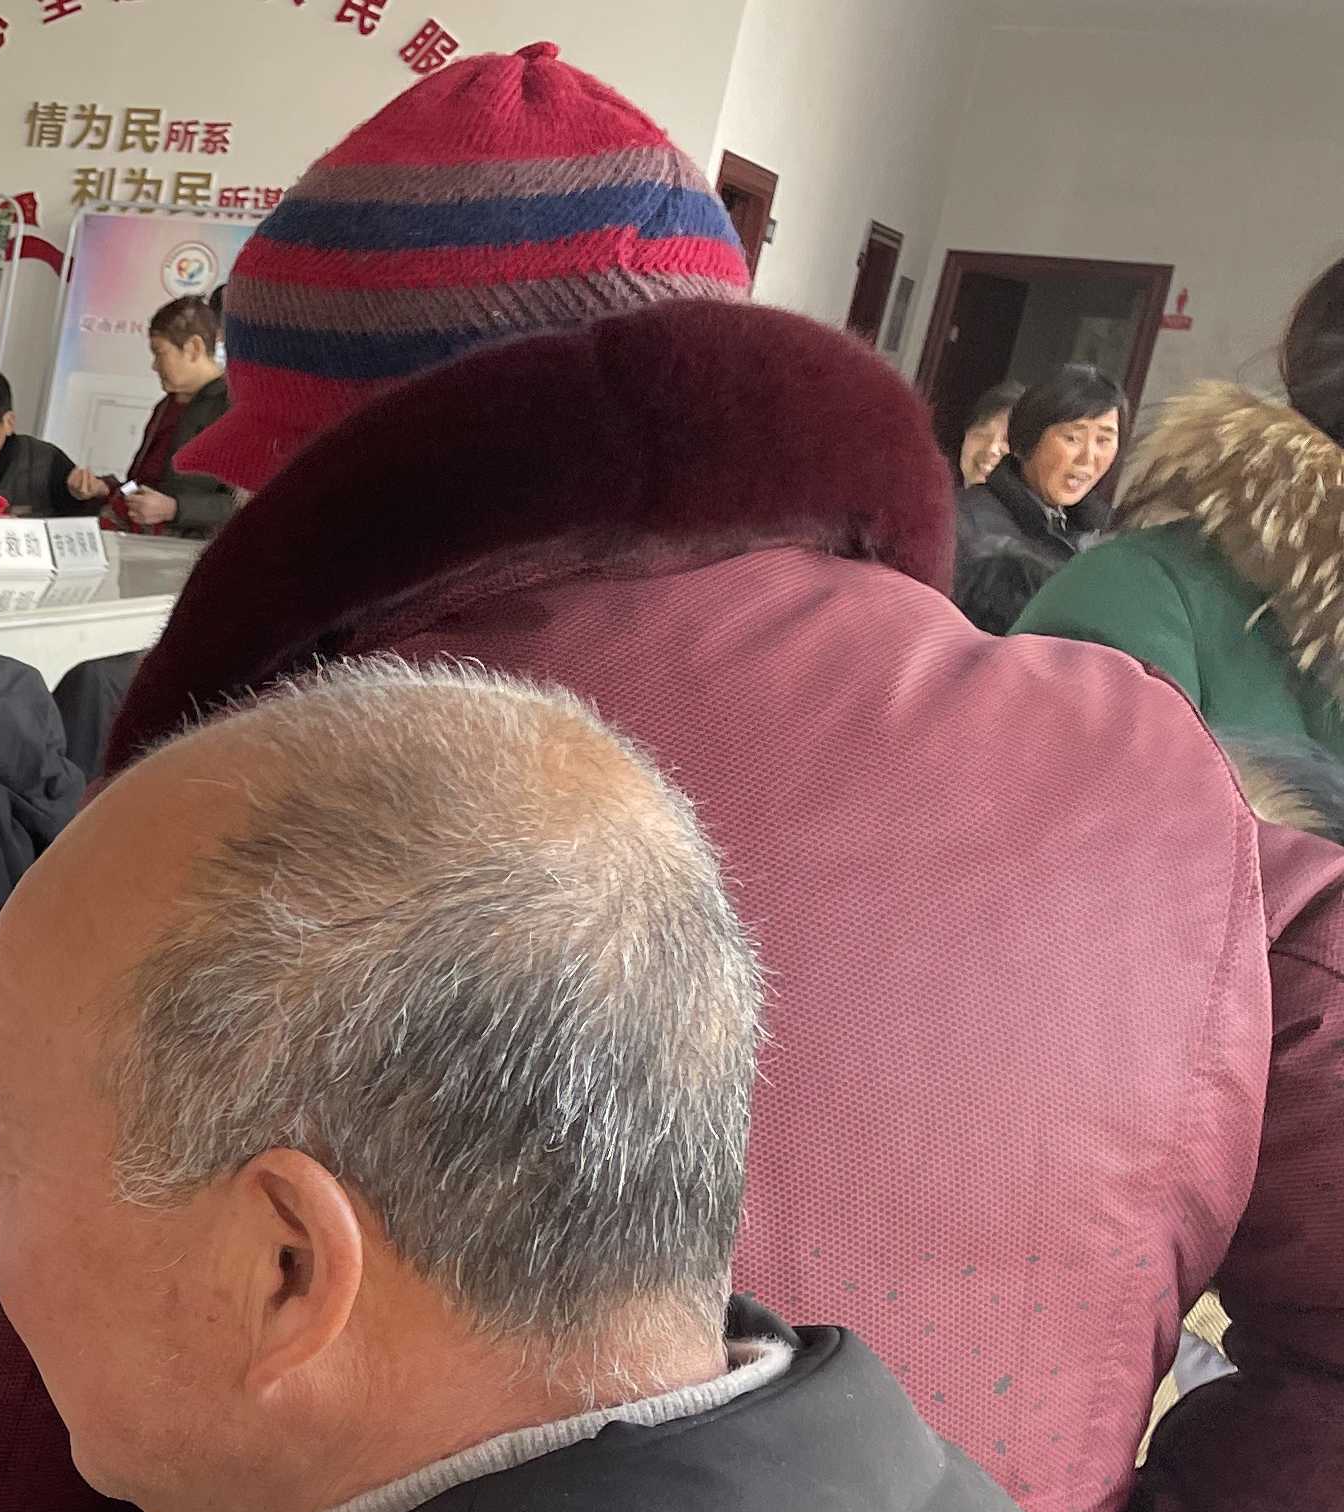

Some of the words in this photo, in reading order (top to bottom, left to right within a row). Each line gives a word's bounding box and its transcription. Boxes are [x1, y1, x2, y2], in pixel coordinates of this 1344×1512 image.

[24, 101, 232, 155] 情为民所系
